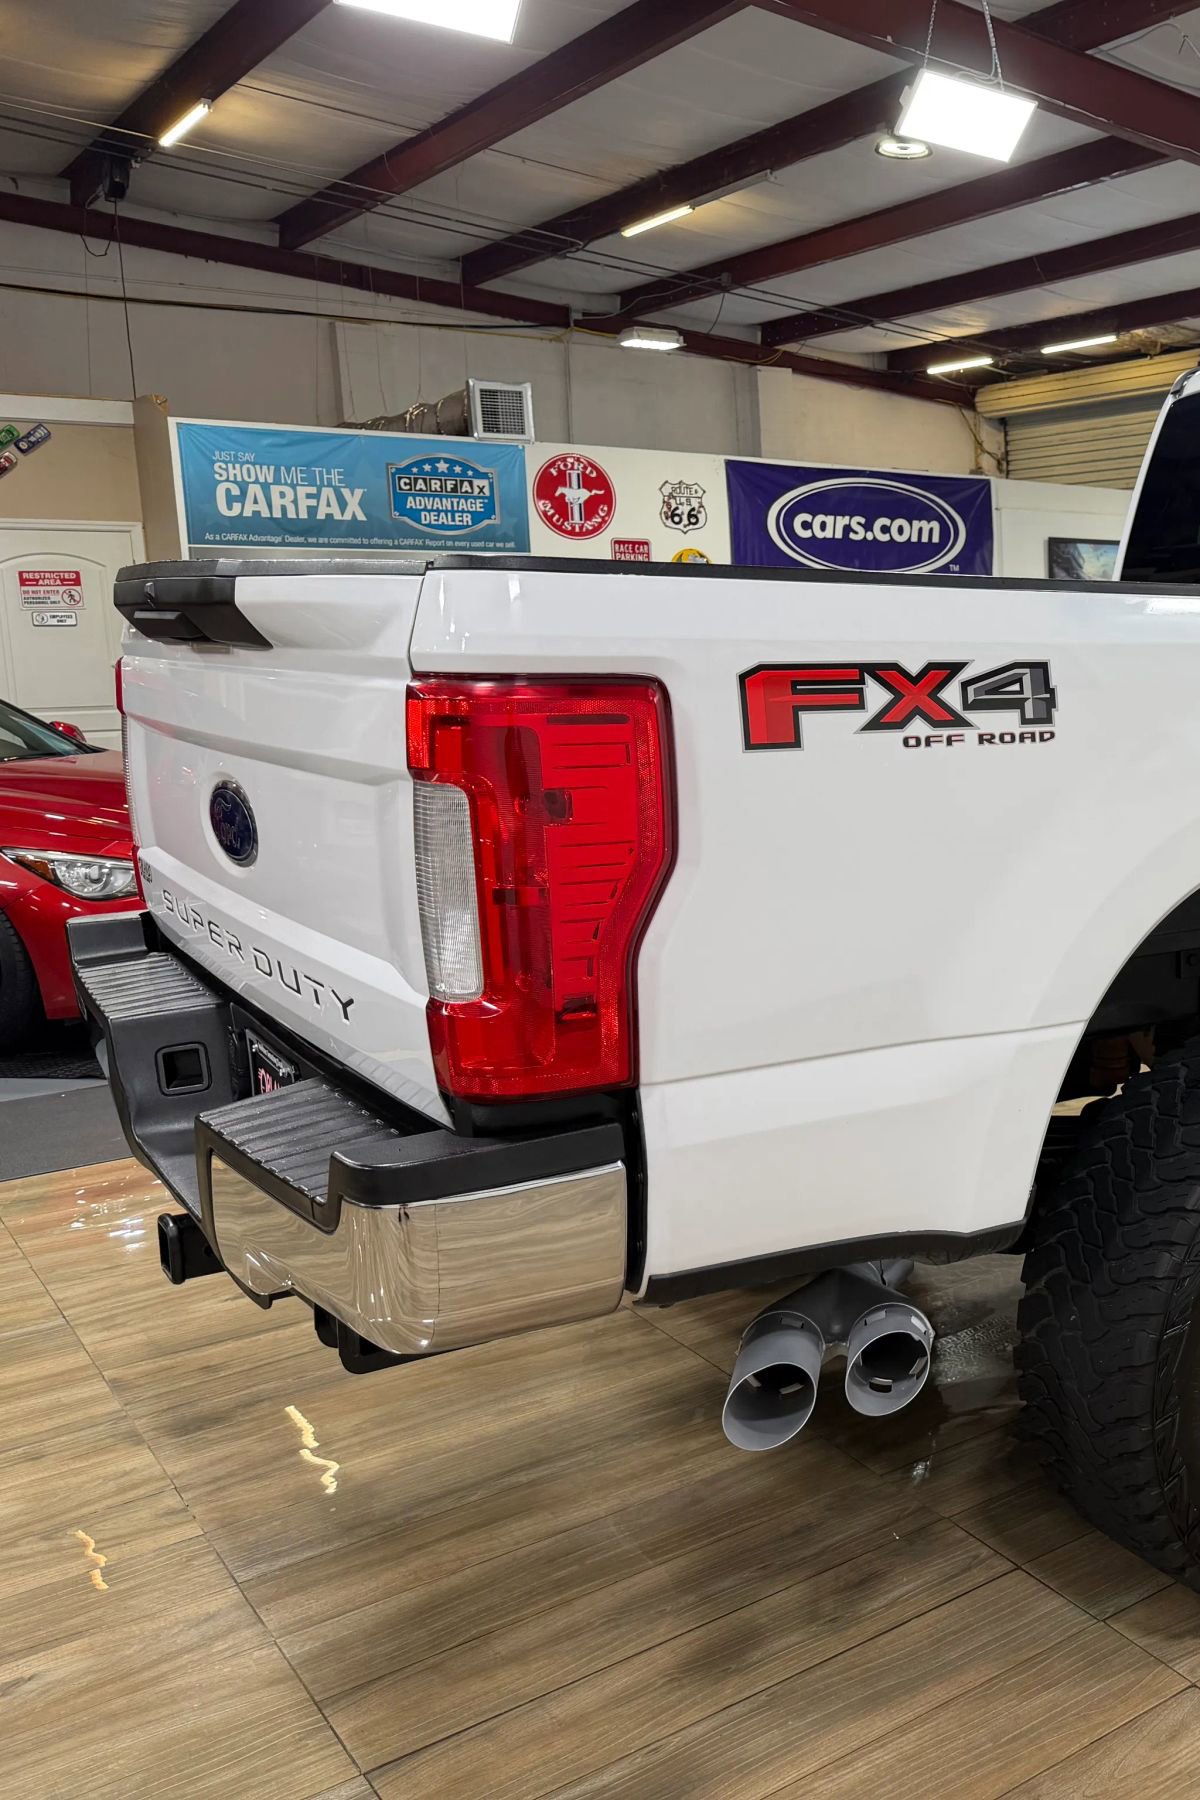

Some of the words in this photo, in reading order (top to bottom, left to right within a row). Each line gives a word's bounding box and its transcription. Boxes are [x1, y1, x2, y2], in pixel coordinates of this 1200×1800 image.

[212, 451, 235, 462] JUST
[238, 452, 256, 462] SAY
[213, 462, 275, 483] SHOW
[280, 467, 308, 485] ME
[311, 467, 346, 486] THE
[549, 460, 597, 478] FORD
[398, 477, 488, 495] CARFAX
[215, 482, 367, 521] CARFAX
[406, 496, 484, 512] ADVANTAGE
[420, 512, 472, 526] DEALER
[538, 499, 609, 532] MUSTANG
[670, 506, 700, 527] 66
[792, 511, 941, 544] cars.com
[614, 543, 633, 553] RACE
[635, 544, 649, 554] CAR
[615, 553, 649, 561] PARKING
[736, 659, 1059, 753] FX4
[902, 734, 966, 749] OFF
[977, 731, 1056, 746] ROAD
[162, 888, 246, 963] SUPER
[252, 946, 355, 1024] DUTY
